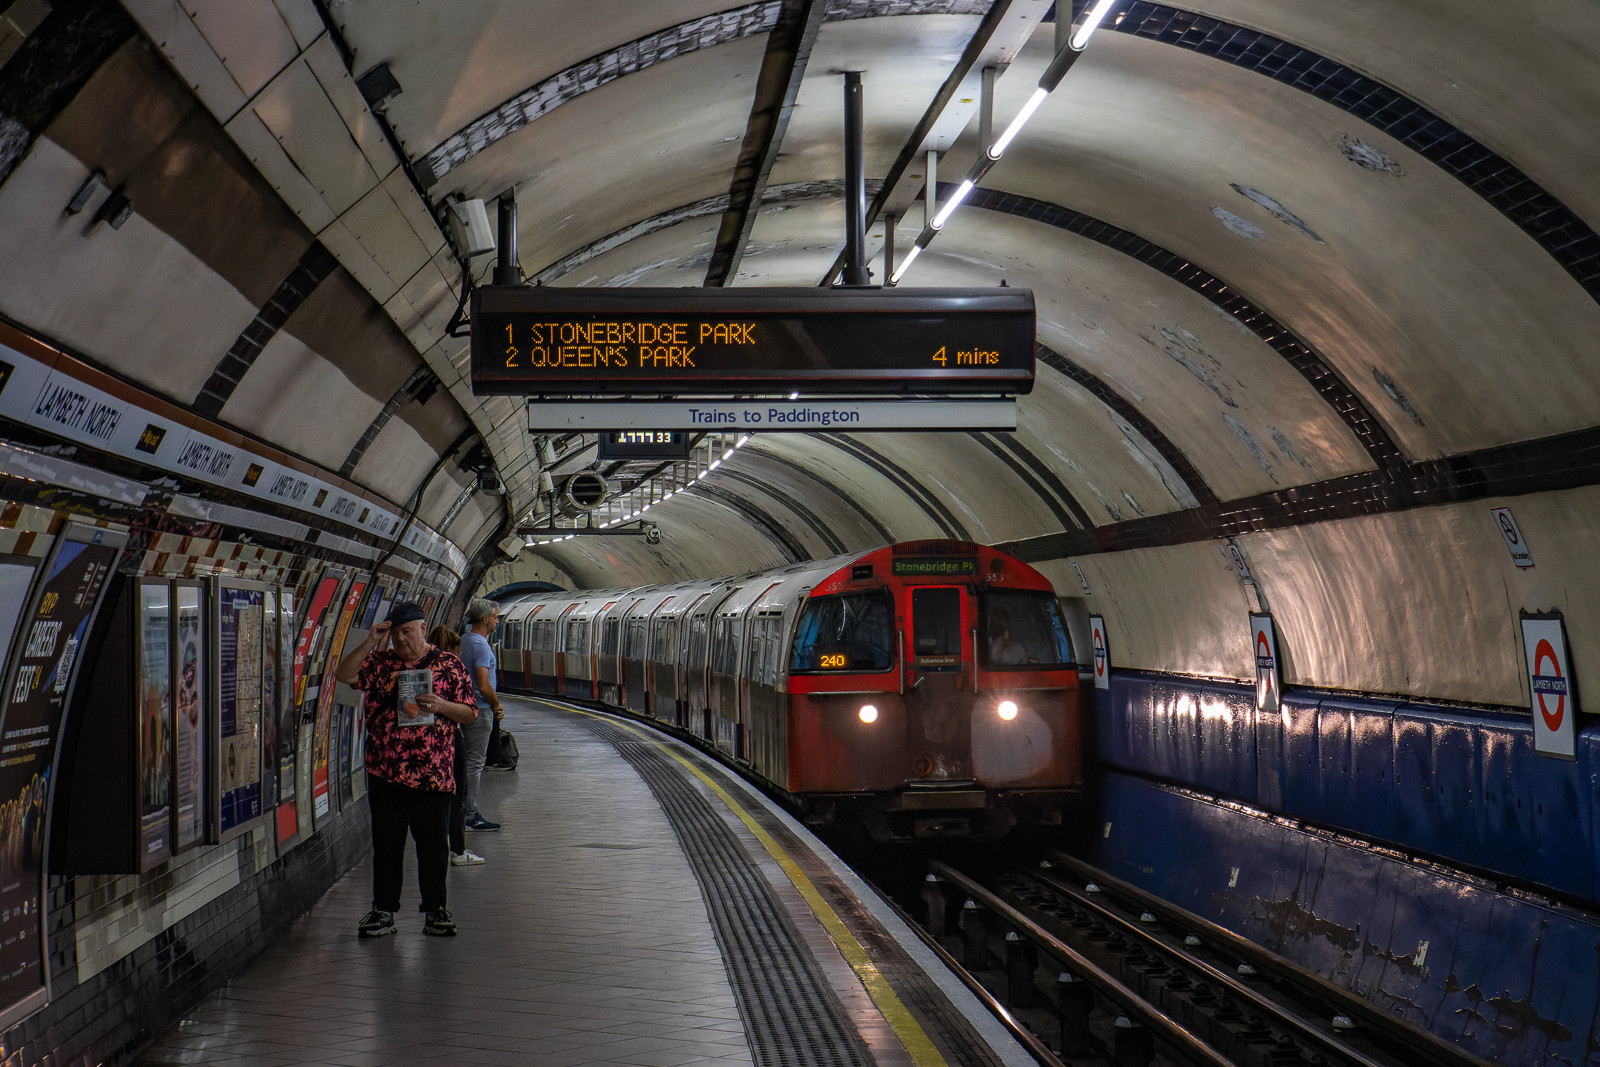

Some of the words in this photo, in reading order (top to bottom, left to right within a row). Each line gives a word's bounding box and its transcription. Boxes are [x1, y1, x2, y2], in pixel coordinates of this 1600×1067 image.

[506, 323, 513, 344] 1
[531, 323, 688, 344] STONEBRIDGE
[700, 323, 756, 344] PARK
[506, 346, 519, 368] 2
[531, 346, 628, 368] QUEEN'S
[640, 346, 696, 368] PARK
[932, 346, 947, 367] 4
[957, 347, 999, 365] mins
[35, 382, 92, 429] LAMBETH
[81, 401, 123, 441] NORTH
[689, 408, 736, 423] Trains
[743, 409, 761, 423] to
[768, 408, 860, 425] Paddington
[177, 438, 215, 471] LAMBETH
[206, 449, 235, 479] NORTH
[895, 561, 958, 574] Stonebridge
[962, 561, 975, 571] Pk
[24, 621, 63, 658] CAREERS
[820, 655, 845, 667] 240
[12, 665, 37, 703] FEST
[1533, 679, 1552, 690] LAMBETH
[1551, 680, 1566, 691] NORTH
